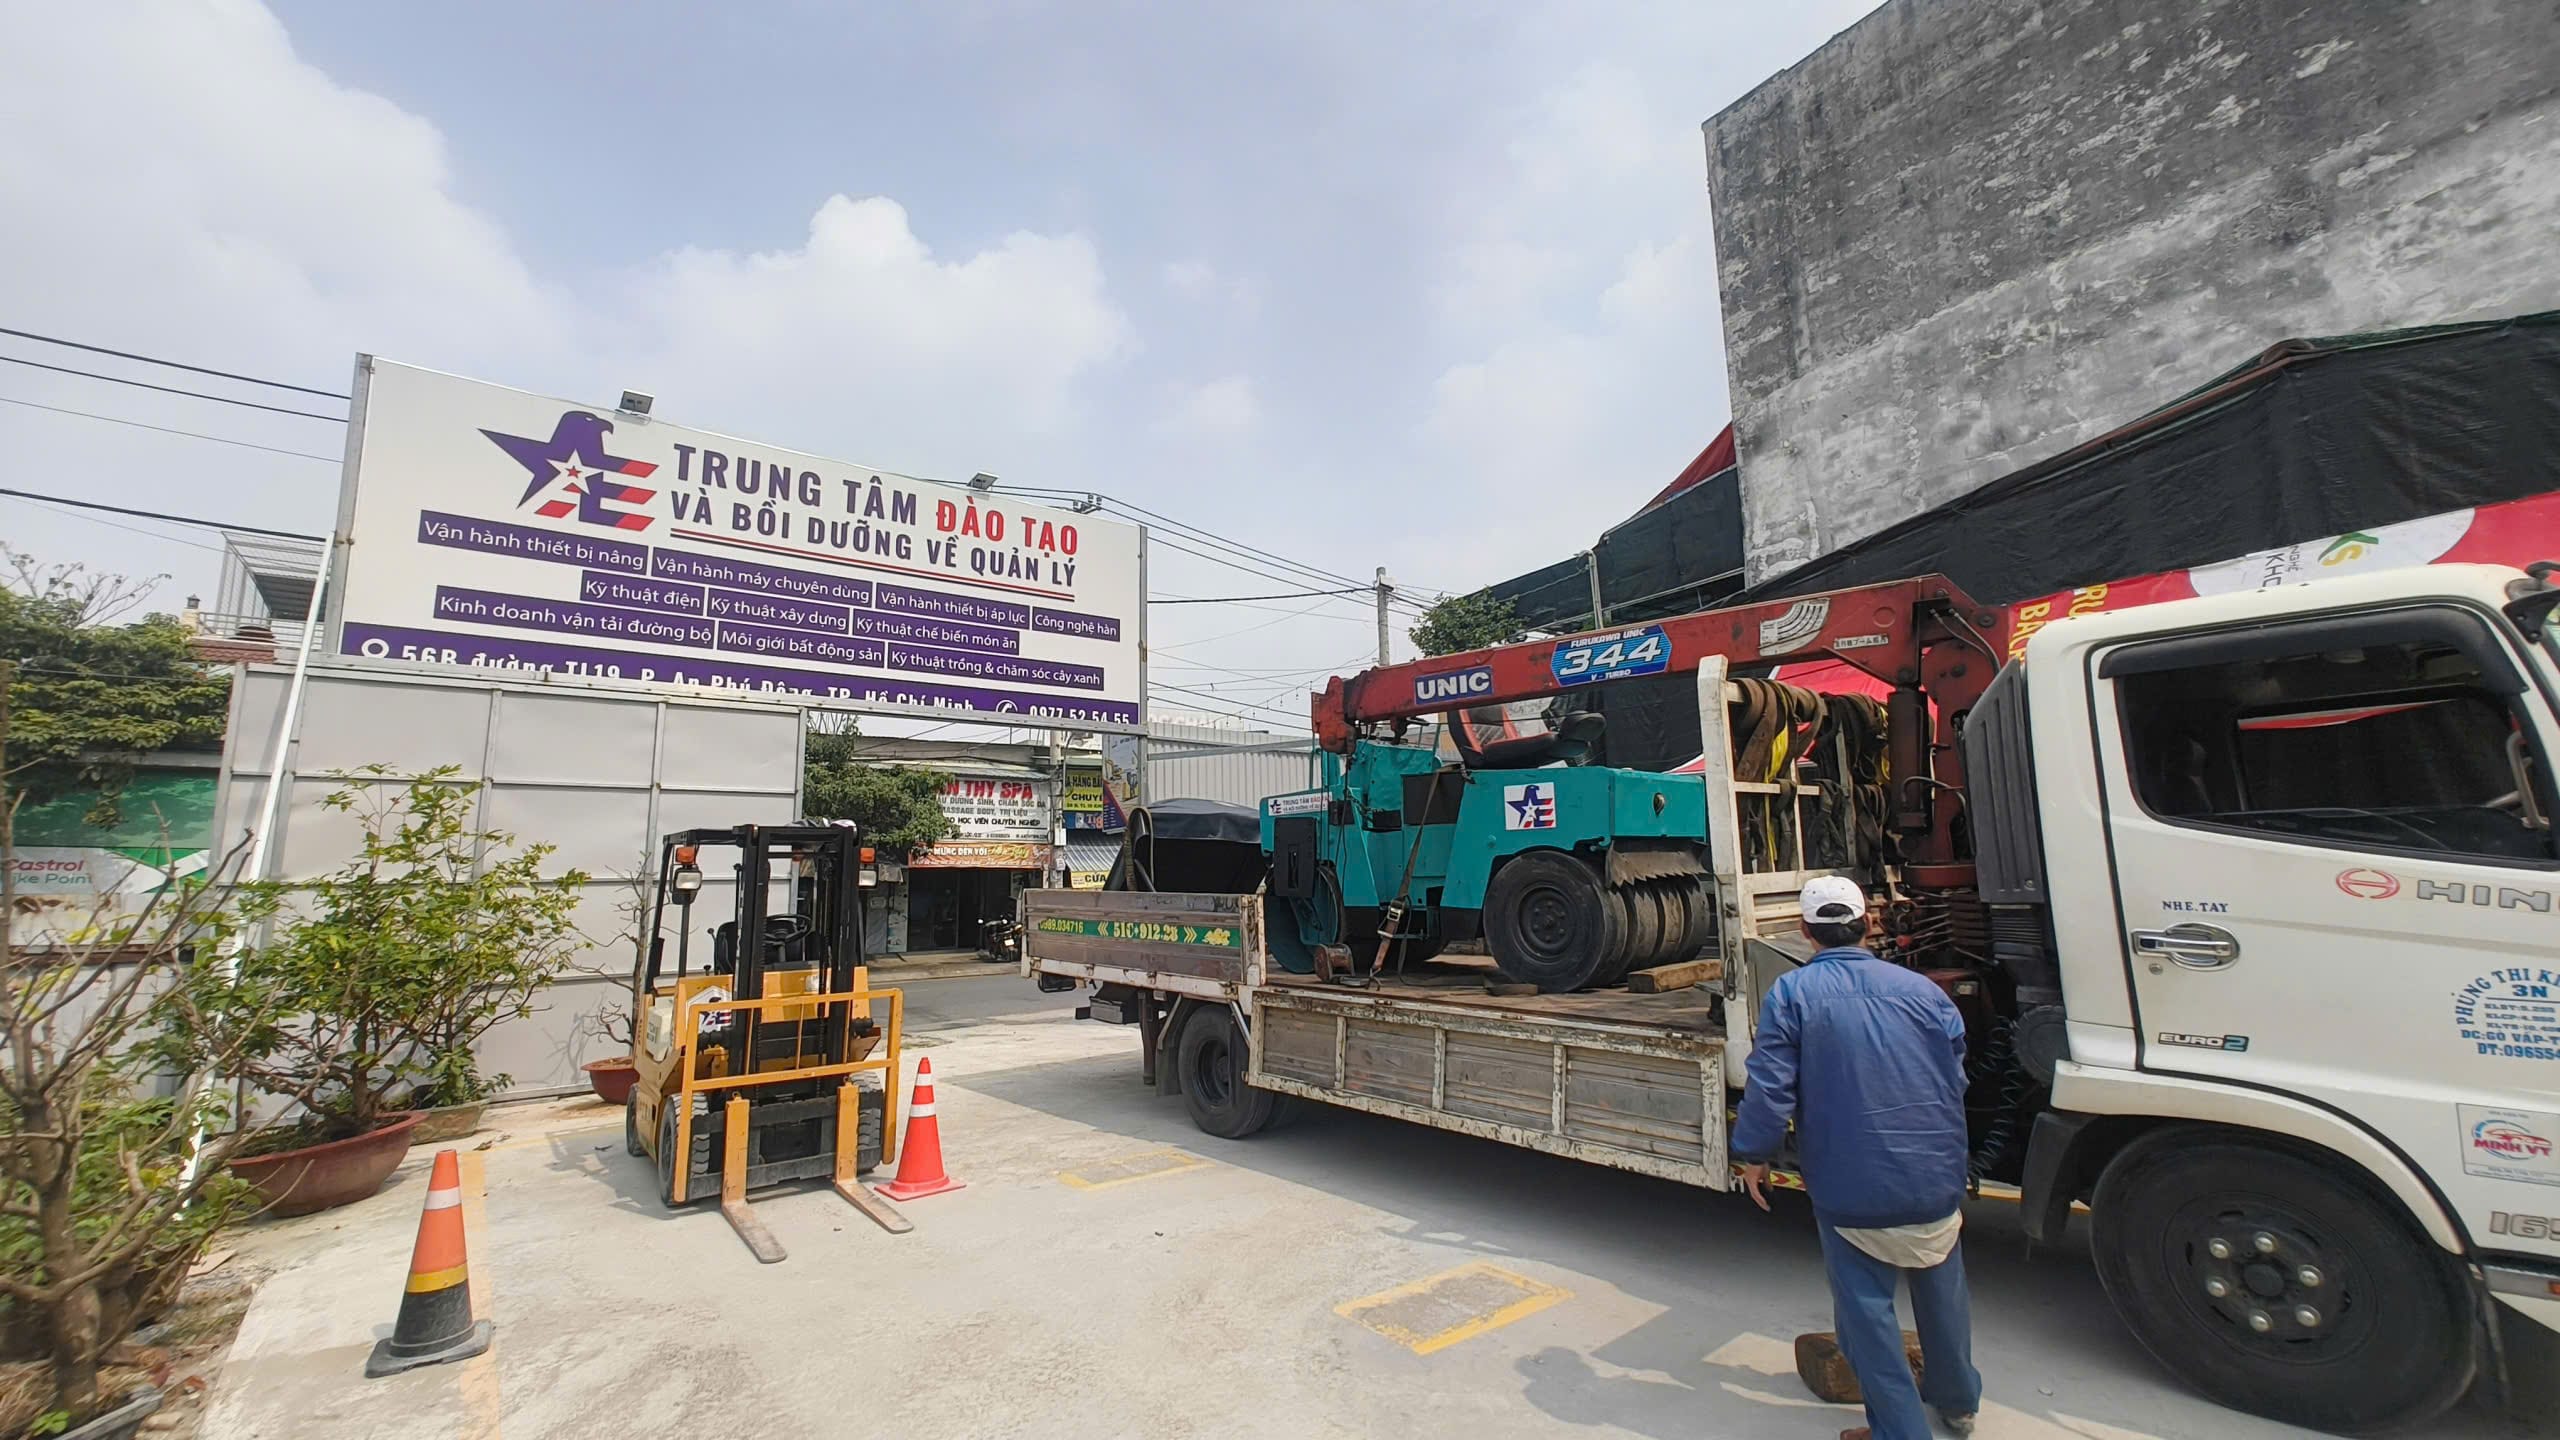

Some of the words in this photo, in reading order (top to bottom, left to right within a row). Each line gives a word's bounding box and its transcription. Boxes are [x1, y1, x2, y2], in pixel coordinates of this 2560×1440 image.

[673, 443, 821, 507] TRUNG
[843, 475, 917, 526] TÂM
[936, 496, 1005, 542] ĐÀO
[1021, 517, 1078, 557] TẠO
[424, 520, 464, 541] Vận
[469, 527, 520, 549] hành
[526, 535, 571, 557] thiết
[576, 541, 593, 563] bị
[599, 545, 644, 570] nâng
[671, 487, 712, 525] VÀ
[732, 500, 791, 539] BỒI
[807, 517, 911, 560] DƯỠNG
[927, 534, 959, 568] VỀ
[970, 547, 1039, 582] QUẢN
[1051, 557, 1076, 587] LÝ
[586, 580, 607, 598] Kỹ
[612, 583, 659, 603] thuật
[663, 590, 701, 609] điện
[656, 556, 687, 575] Vận
[693, 562, 734, 582] hành
[738, 571, 771, 589] máy
[775, 576, 828, 596] chuyên
[832, 584, 870, 604] dùng
[439, 596, 487, 617] Kinh
[493, 601, 557, 625] doanh
[562, 612, 596, 629] vận
[600, 614, 622, 632] tải
[627, 618, 684, 641] đường
[690, 621, 711, 642] bộ
[711, 598, 730, 615] Kỹ
[734, 600, 775, 619] thuật
[779, 607, 805, 624] xây
[808, 611, 847, 630] dựng
[881, 591, 906, 606] Vận
[909, 593, 941, 612] hành
[945, 599, 973, 616] thiết
[977, 606, 988, 621] bị
[991, 607, 1006, 623] áp
[1009, 610, 1025, 625] lực
[856, 617, 873, 632] Kỹ
[877, 619, 912, 636] thuật
[915, 625, 938, 640] chế
[941, 629, 969, 644] biến
[972, 635, 999, 647] món
[1002, 637, 1017, 649] ăn
[1035, 614, 1064, 632] Công
[1067, 620, 1095, 634] nghệ
[1097, 622, 1117, 637] hàn
[1570, 632, 1621, 649] FURUKAWA
[1622, 628, 1646, 639] UNIC
[722, 630, 752, 647] Môi
[756, 636, 785, 652] giới
[789, 639, 814, 655] bất
[817, 642, 855, 661] động
[858, 647, 882, 662] sản
[1560, 636, 1662, 676] 344
[891, 651, 907, 666] Kỹ
[911, 652, 944, 669] thuật
[948, 656, 982, 674] trồng
[985, 661, 994, 674] &
[996, 664, 1029, 678] chăm
[1031, 667, 1050, 680] sóc
[1053, 670, 1072, 684] cây
[1074, 671, 1101, 685] xanh
[1416, 671, 1490, 700] UNIC
[964, 780, 996, 798] THY
[999, 782, 1033, 800] SPA
[2417, 880, 2560, 913] HIN
[2511, 984, 2548, 999] 3N
[2474, 1138, 2523, 1156] MINH
